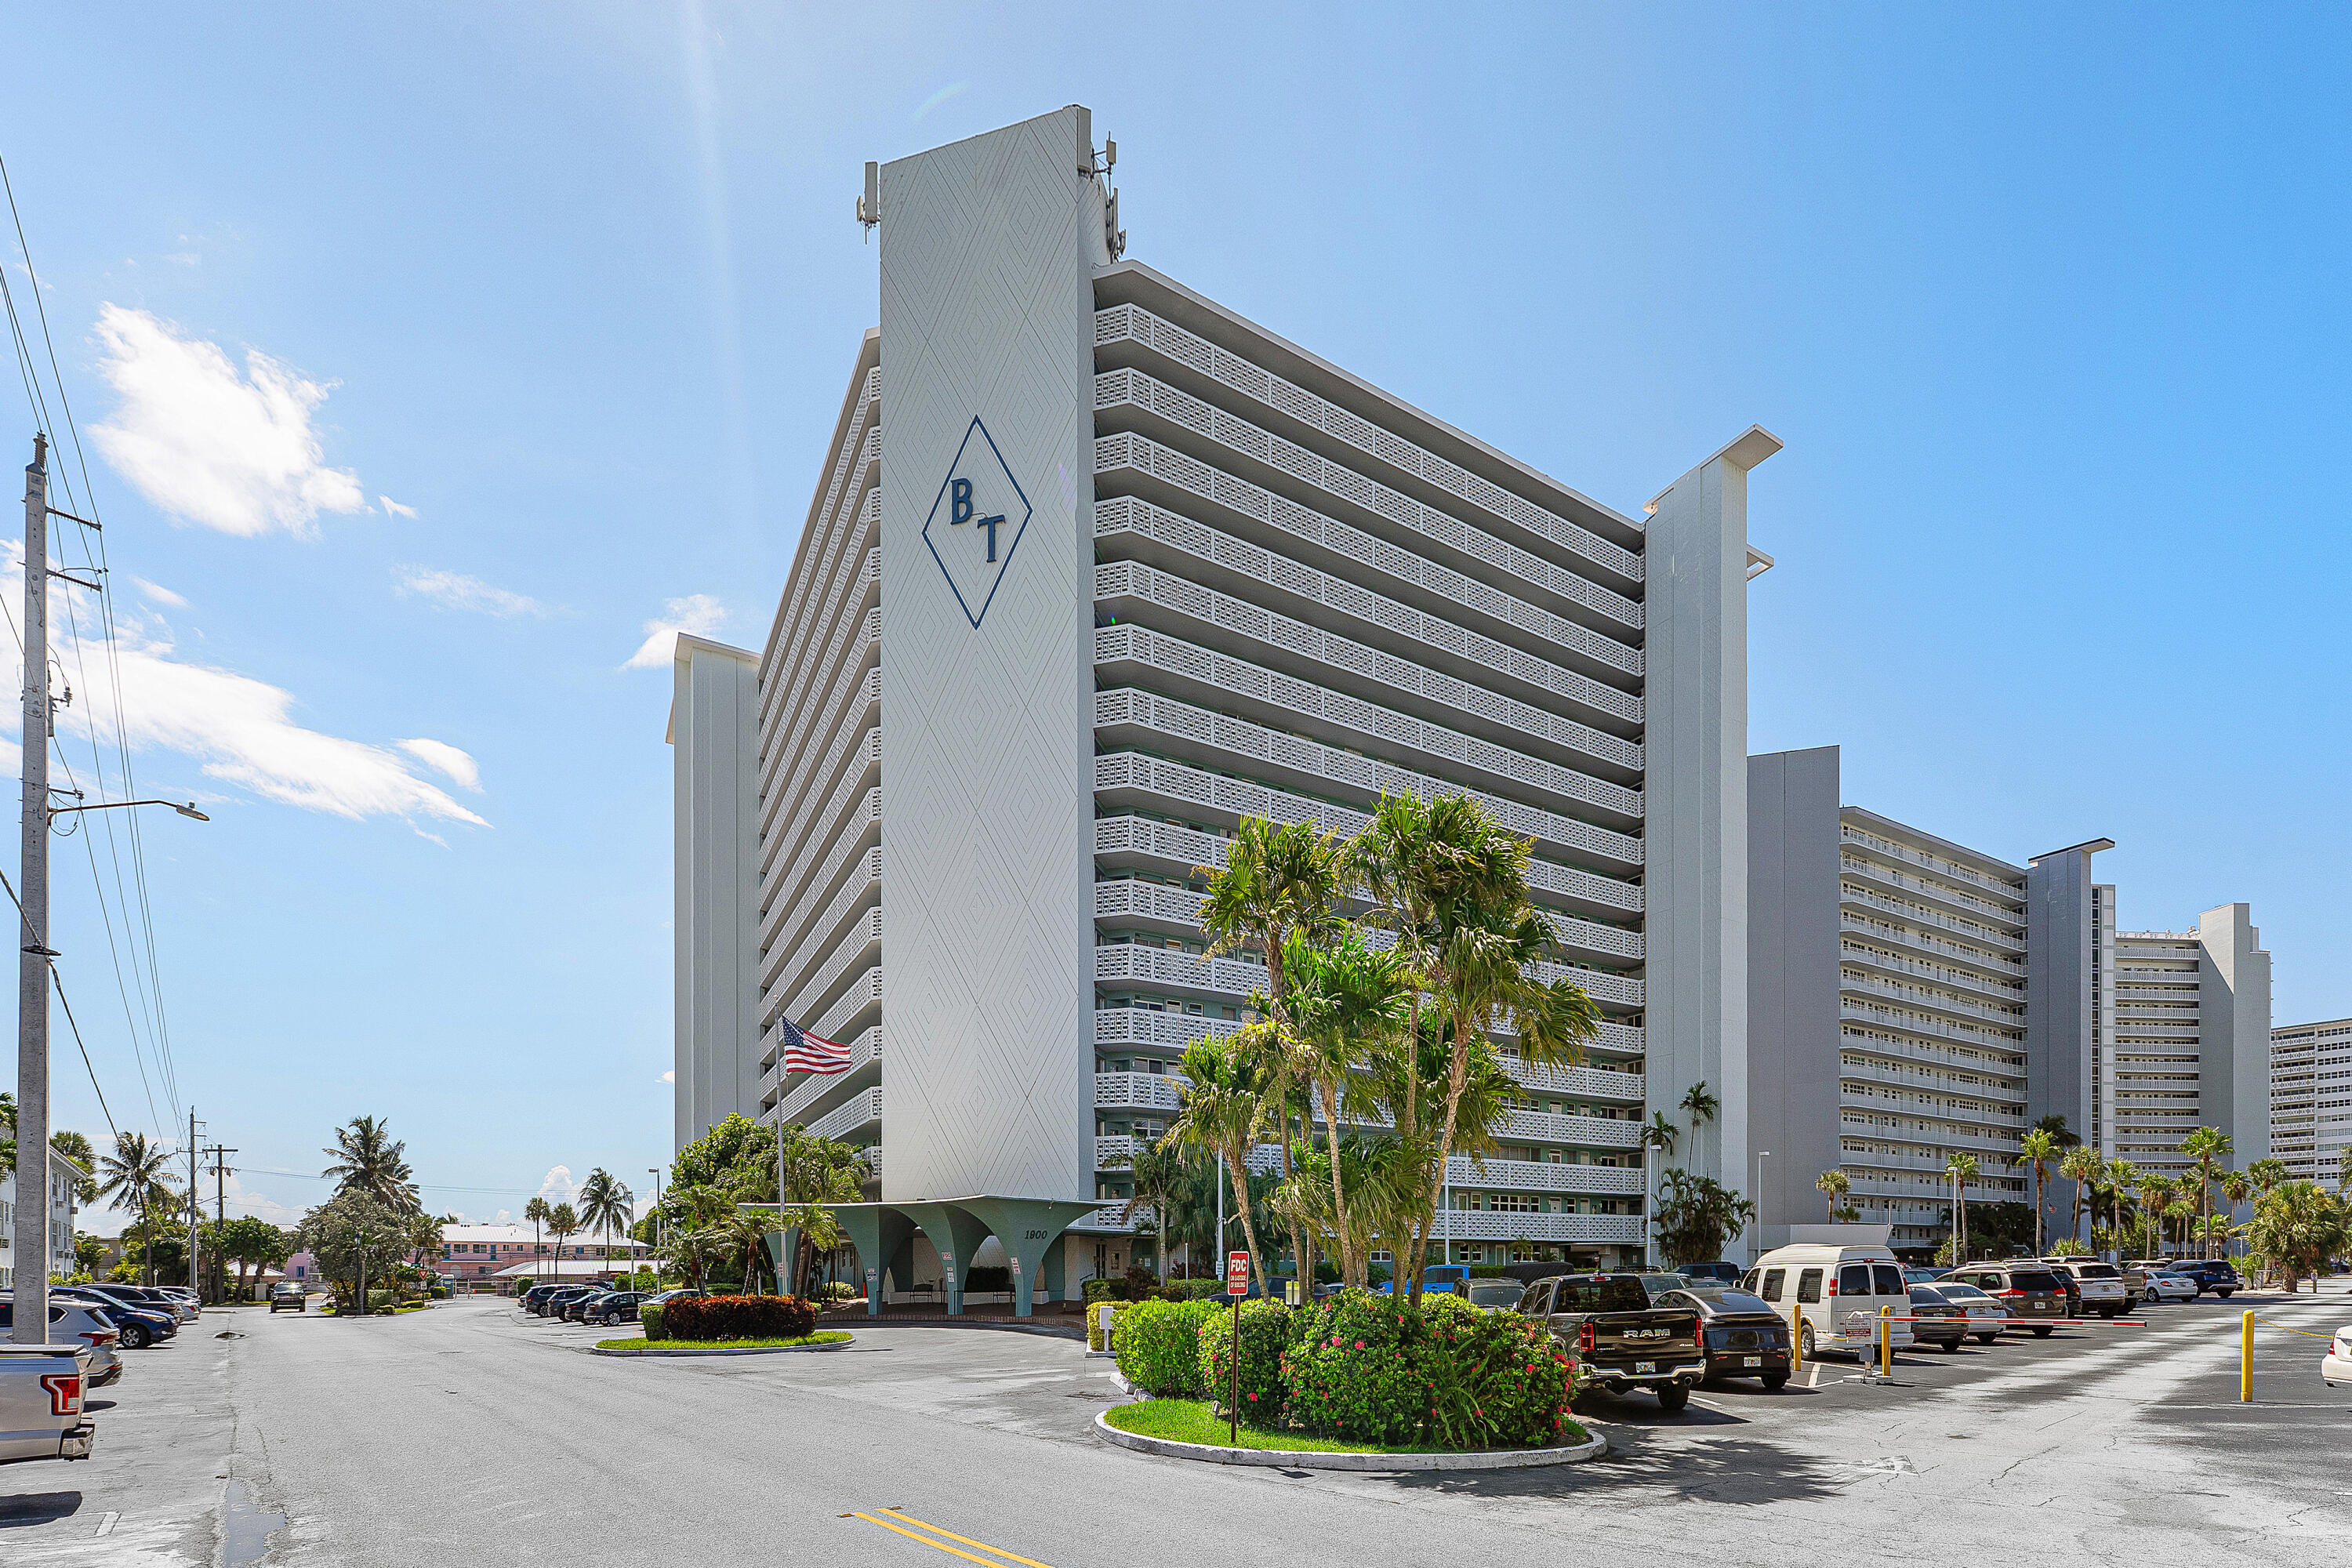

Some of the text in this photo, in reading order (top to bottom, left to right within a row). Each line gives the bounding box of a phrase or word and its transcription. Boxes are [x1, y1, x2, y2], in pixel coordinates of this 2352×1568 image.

[1025, 1230, 1048, 1240] 1800
[1231, 1259, 1247, 1272] FDC
[1623, 1329, 1670, 1338] RAM
